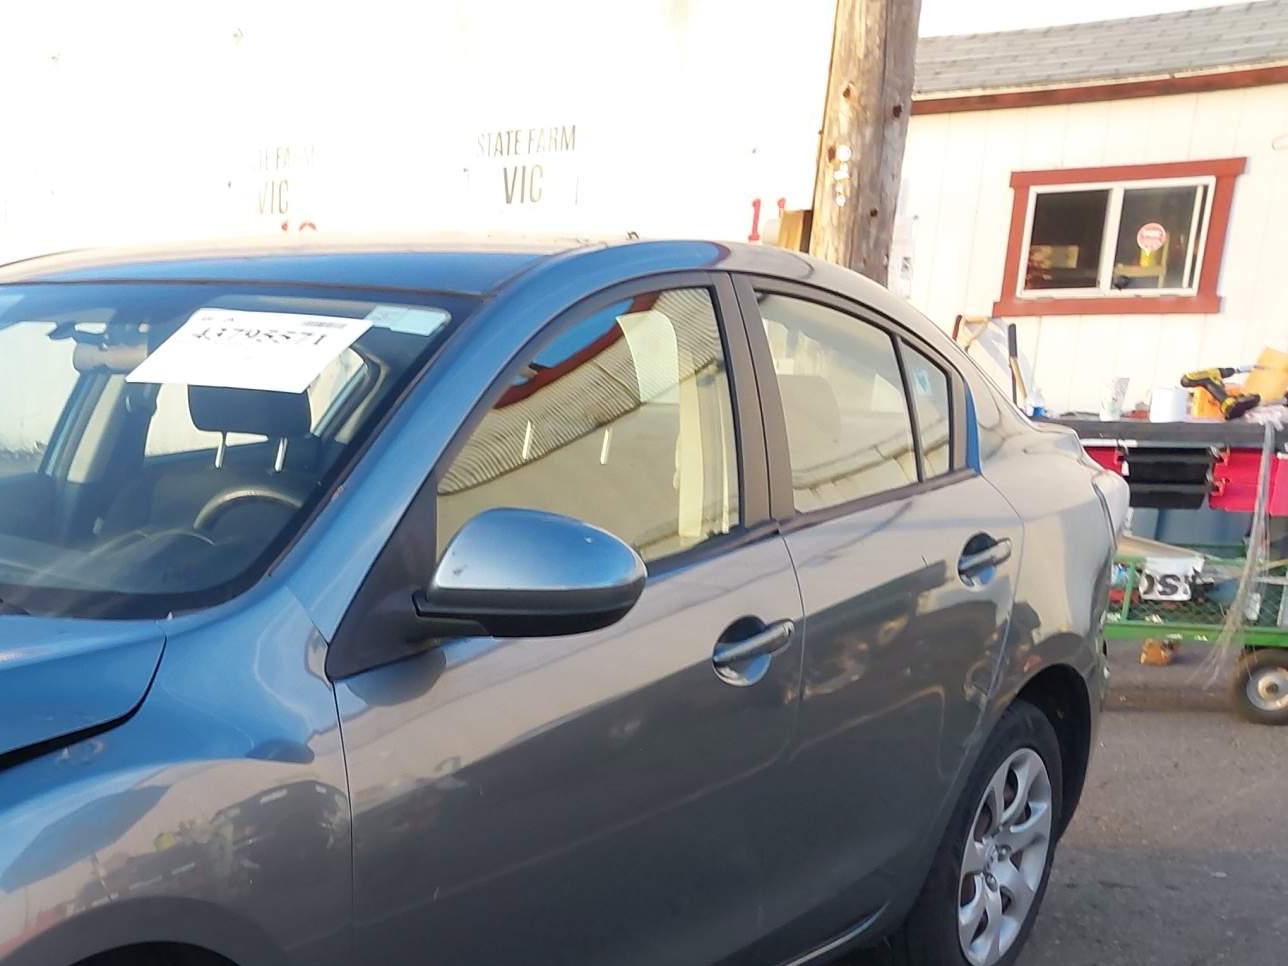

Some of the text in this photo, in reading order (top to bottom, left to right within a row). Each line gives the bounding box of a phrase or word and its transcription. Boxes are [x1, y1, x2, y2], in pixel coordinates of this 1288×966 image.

[474, 124, 576, 158] STATE FARM
[258, 178, 289, 214] VIC
[503, 163, 543, 205] VIC
